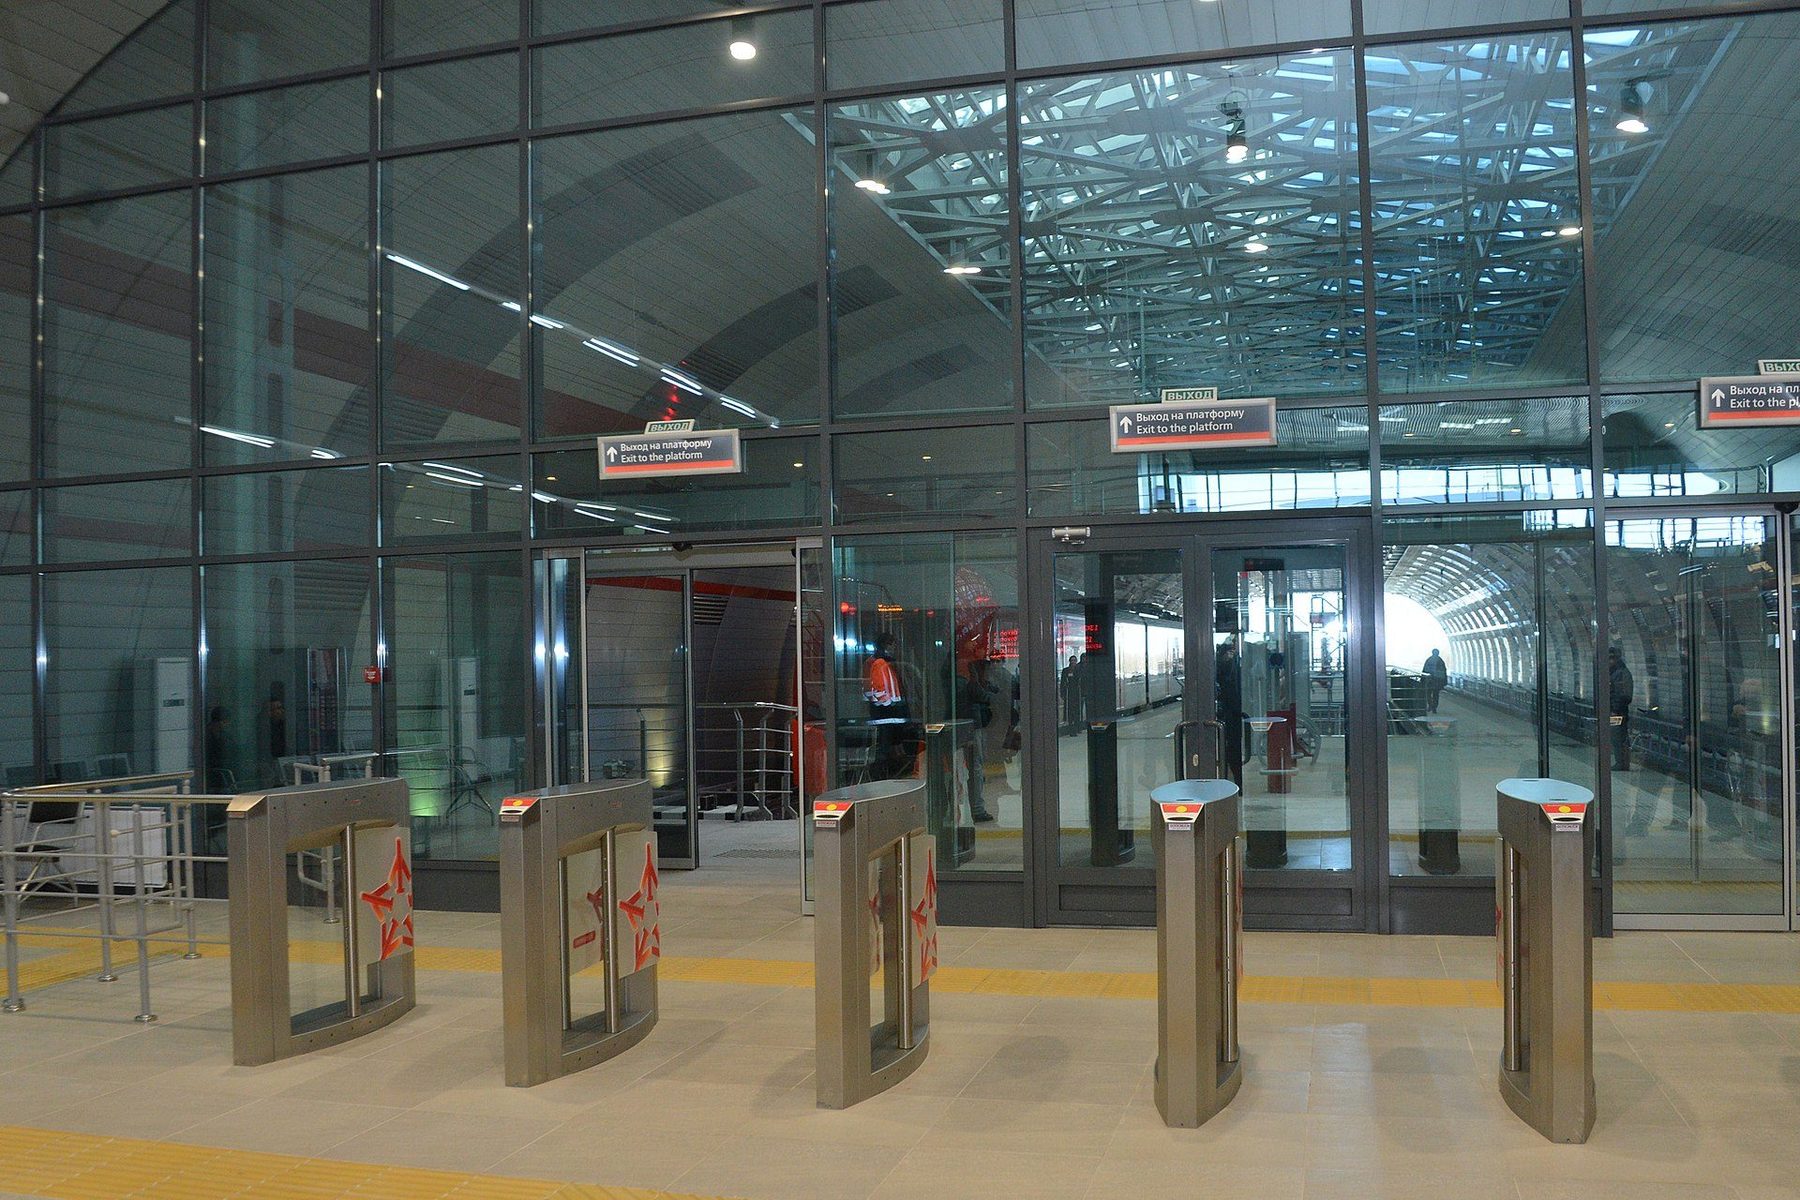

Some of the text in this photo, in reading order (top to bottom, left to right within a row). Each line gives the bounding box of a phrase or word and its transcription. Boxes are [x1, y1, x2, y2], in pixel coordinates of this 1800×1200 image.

[1168, 391, 1212, 400] ВЫХОД
[1730, 386, 1766, 396] Выход
[1769, 386, 1782, 394] на
[1730, 398, 1751, 409] Exit
[1752, 399, 1765, 408] to
[1767, 397, 1785, 407] the
[1136, 409, 1245, 422] Выход на платформу
[651, 423, 689, 432] ВЫХОД
[1136, 422, 1233, 435] Exit to the platform
[620, 443, 649, 452] Выход
[662, 440, 712, 450] платформу
[620, 451, 703, 463] Exit to the platform
